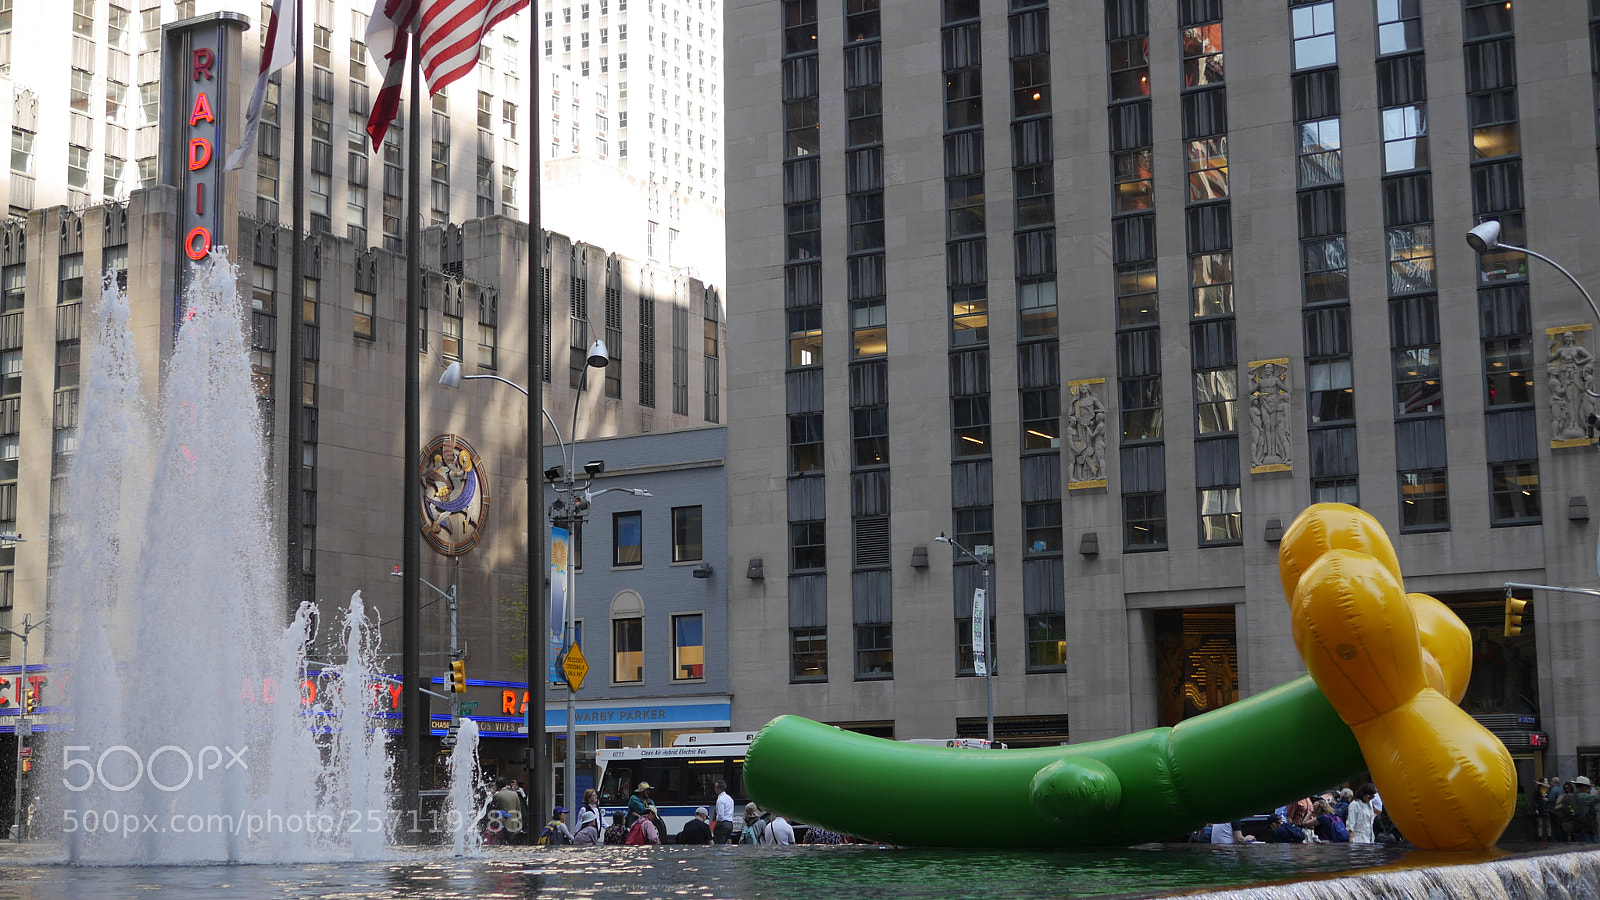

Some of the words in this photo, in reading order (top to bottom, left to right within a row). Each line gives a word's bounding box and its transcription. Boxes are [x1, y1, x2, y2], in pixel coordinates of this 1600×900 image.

[185, 48, 214, 260] RADIO
[575, 711, 614, 721] WARBY
[620, 709, 665, 720] PARKER
[432, 721, 450, 729] CHASE
[495, 722, 515, 731] VIVES
[662, 748, 678, 757] Hybrid
